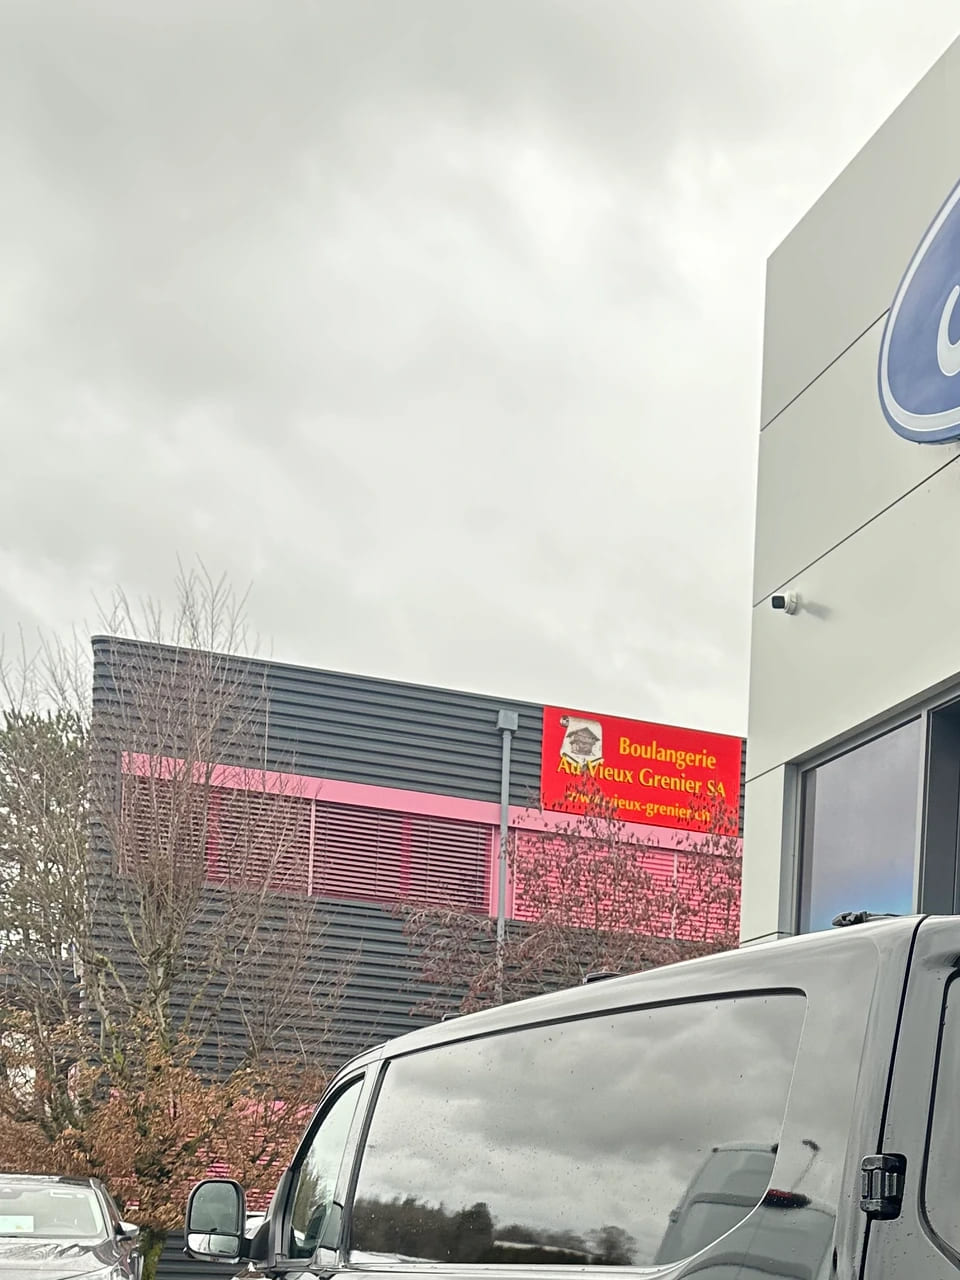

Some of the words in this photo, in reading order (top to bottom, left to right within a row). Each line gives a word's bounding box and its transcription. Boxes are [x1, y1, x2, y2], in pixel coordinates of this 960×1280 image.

[619, 736, 717, 769] Boulangerie
[557, 755, 581, 775] Au
[586, 759, 634, 784] Vieux
[638, 767, 702, 794] Grenier
[706, 779, 726, 798] SA
